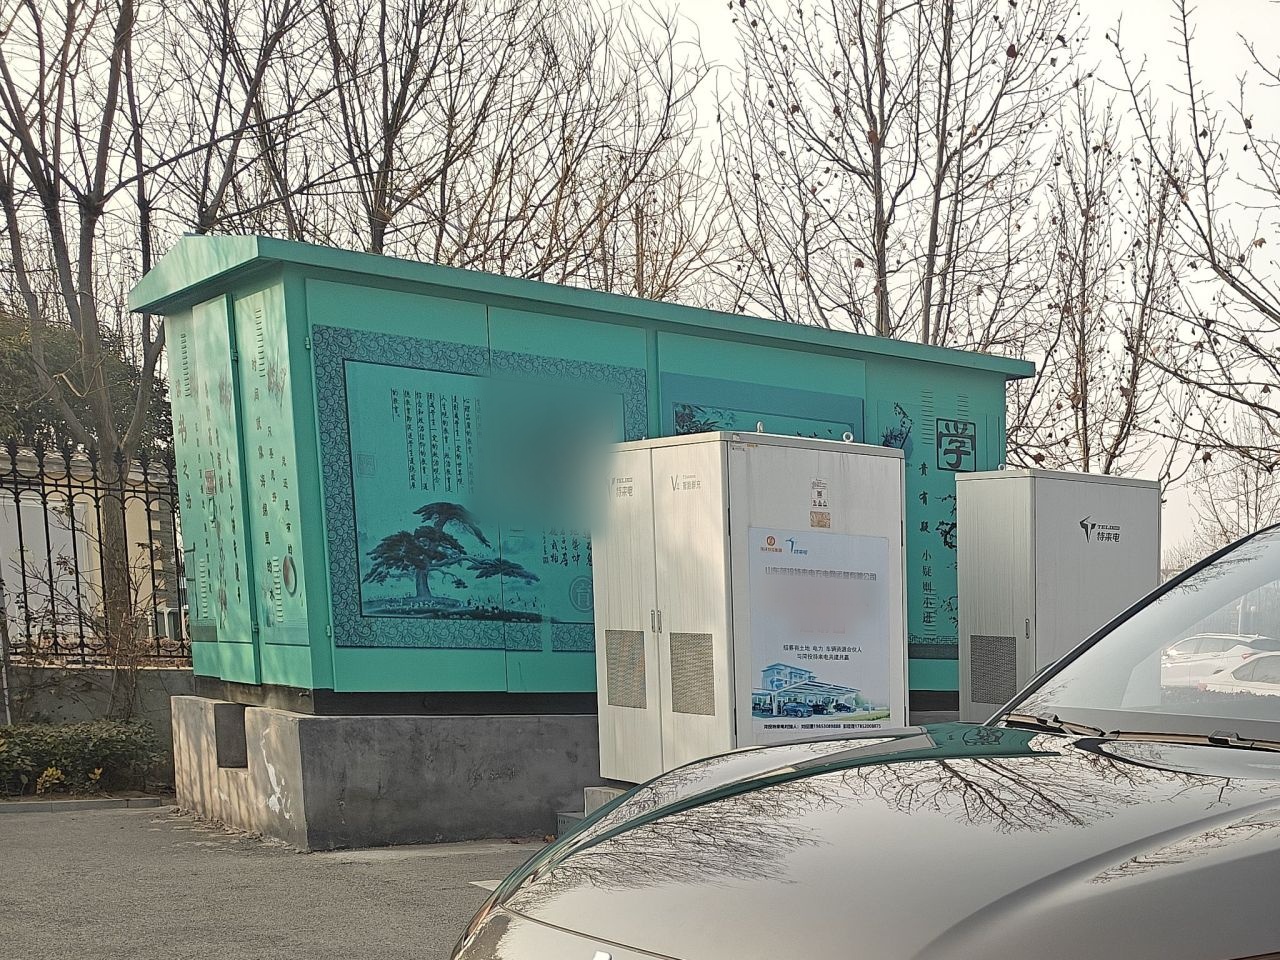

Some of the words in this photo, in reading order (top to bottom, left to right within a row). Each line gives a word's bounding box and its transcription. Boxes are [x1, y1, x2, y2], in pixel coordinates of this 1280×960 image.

[940, 423, 976, 469] 学
[1096, 531, 1121, 543] 特来电
